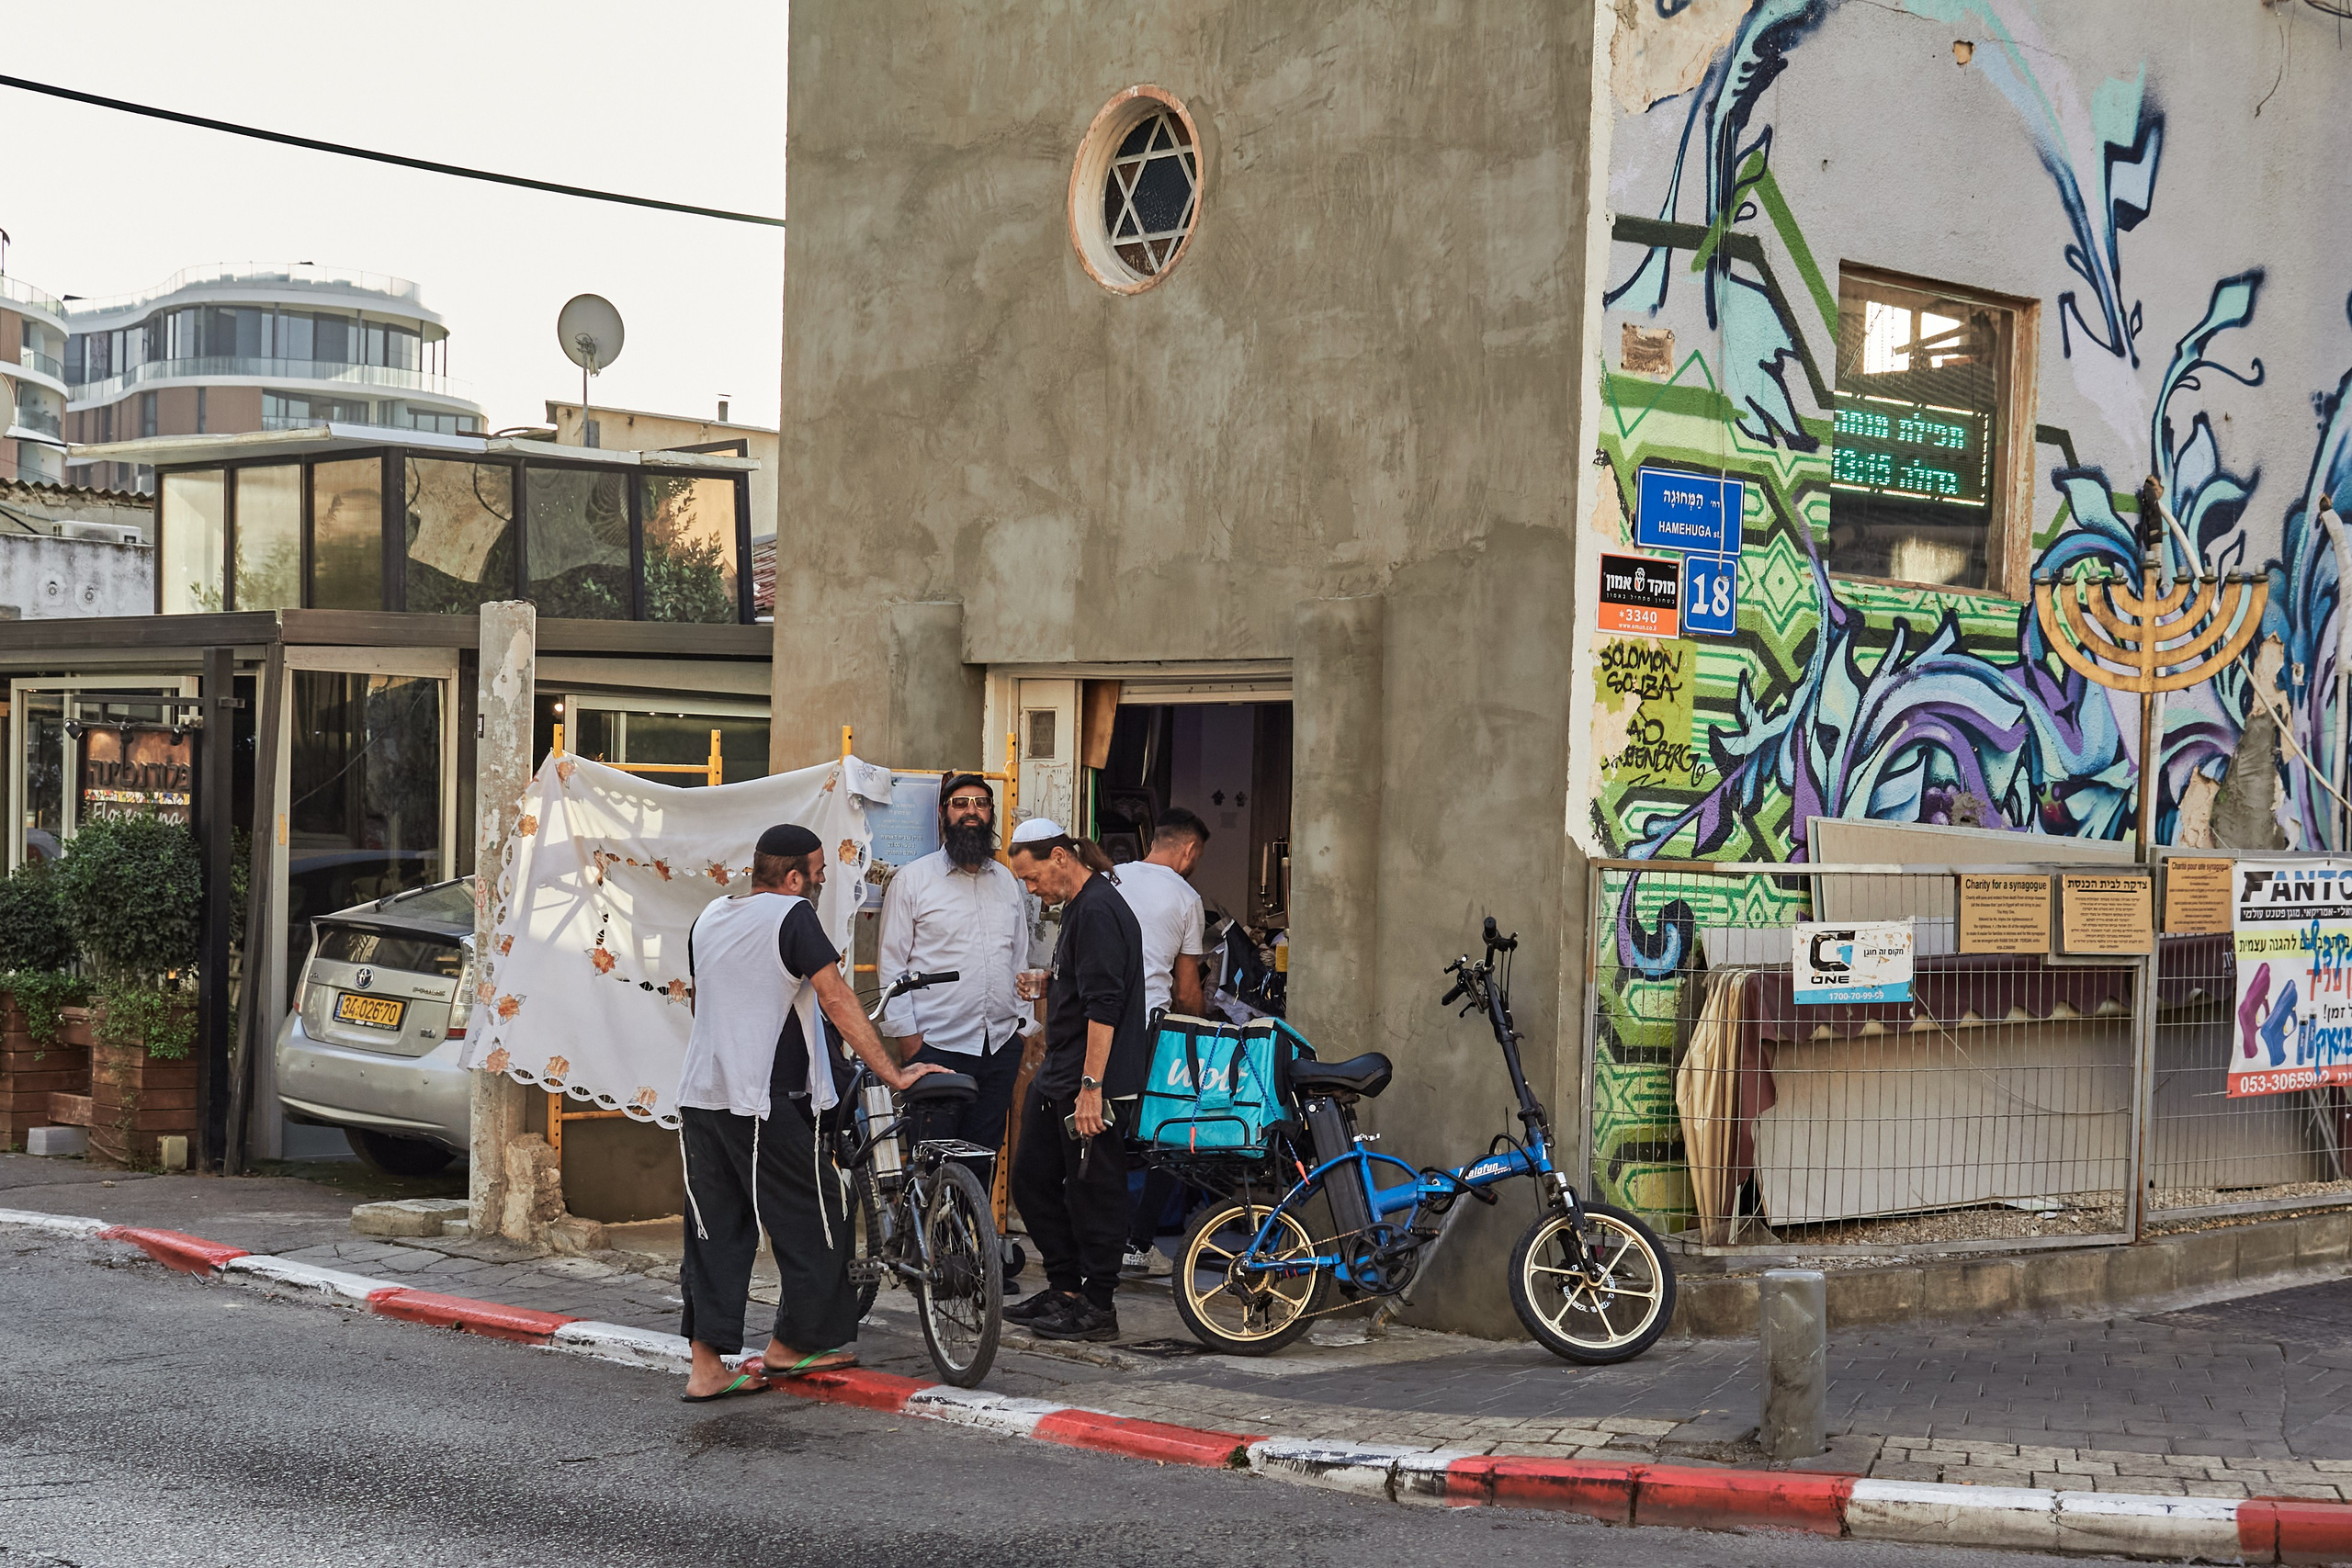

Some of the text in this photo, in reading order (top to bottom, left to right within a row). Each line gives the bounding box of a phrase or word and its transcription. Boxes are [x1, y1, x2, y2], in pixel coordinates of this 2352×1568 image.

[1658, 521, 1712, 538] HAMEHUGA
[1606, 574, 1676, 596] מוקד אמון
[1690, 573, 1730, 617] 18
[1600, 643, 1683, 674] SOLOMON
[1965, 879, 1990, 892] Charity
[1992, 879, 2002, 889] for
[2009, 882, 2047, 892] synagogue
[2067, 879, 2147, 890] צדקה לבית הכנסת
[2243, 908, 2263, 919] עולמי
[2239, 938, 2267, 953] עצמית
[2269, 933, 2297, 951] להגנה
[1863, 949, 1877, 957] מוגן
[1887, 948, 1904, 956] מקום
